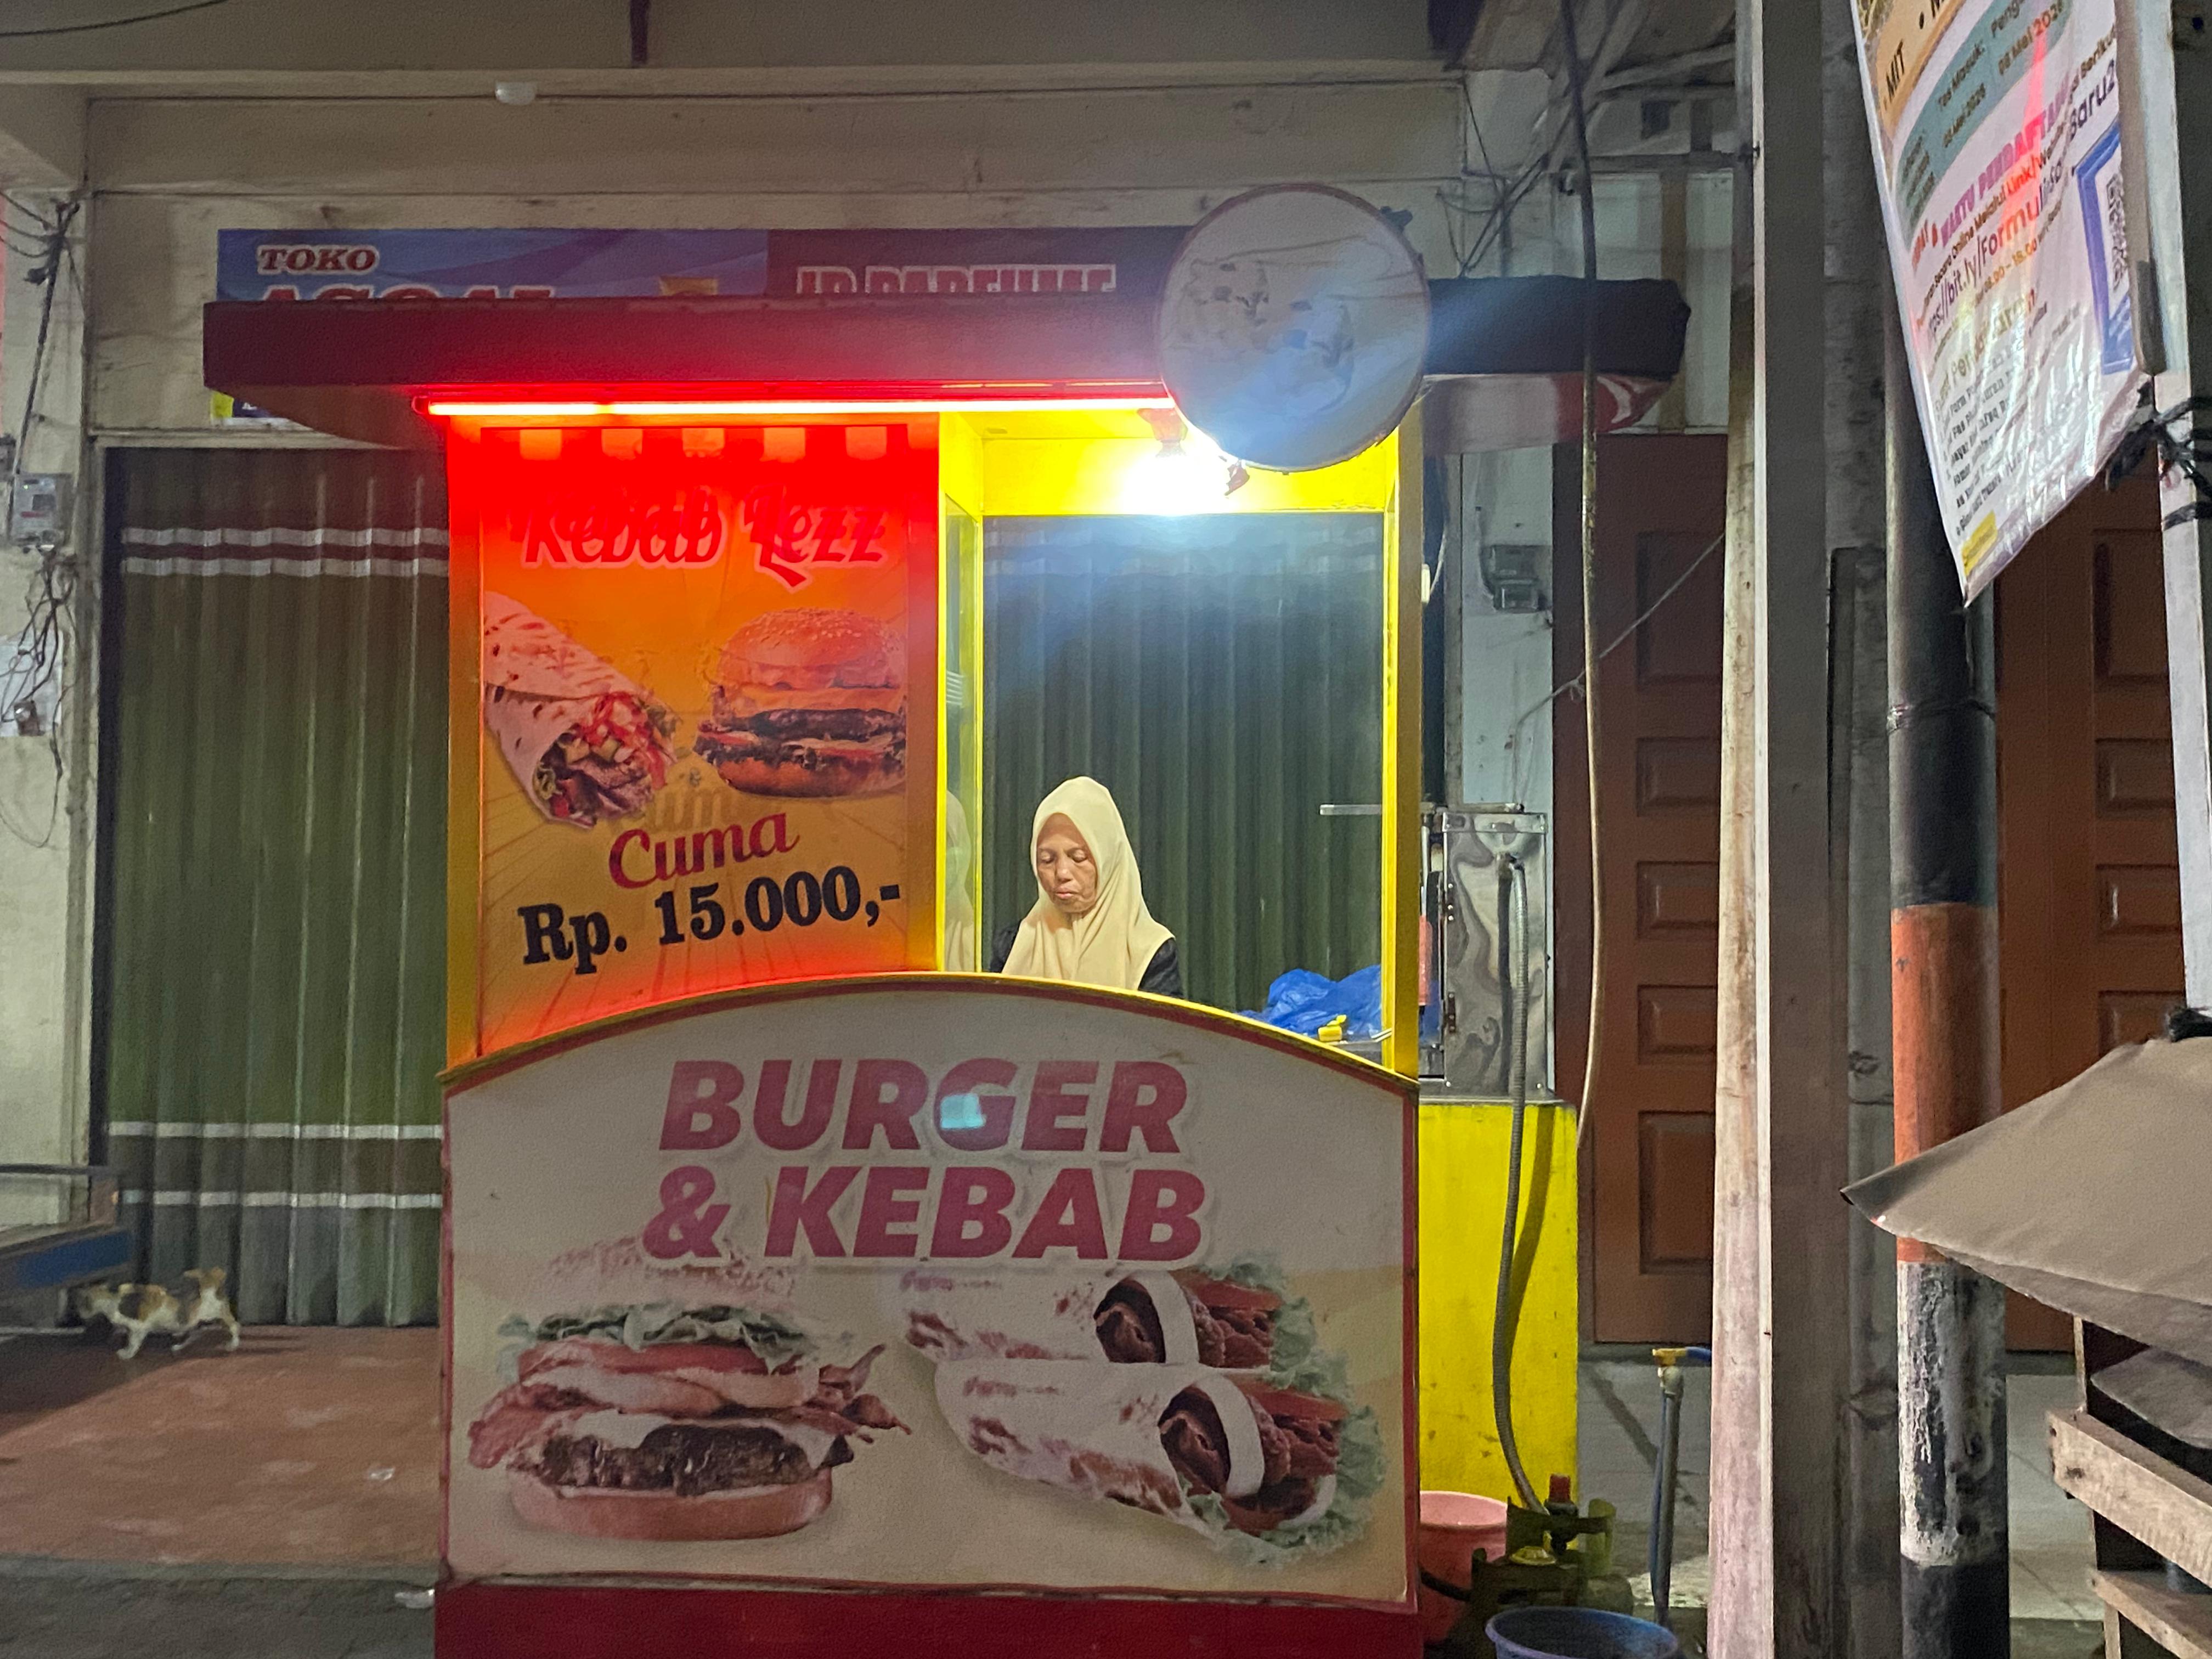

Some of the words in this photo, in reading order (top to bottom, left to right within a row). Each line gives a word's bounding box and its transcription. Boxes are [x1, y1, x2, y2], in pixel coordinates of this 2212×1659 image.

[1885, 38, 1905, 104] MIT
[258, 246, 377, 273] TOKO
[608, 812, 800, 889] Cuma
[517, 902, 627, 975] Rp.
[654, 865, 901, 946] 15.000,-
[659, 1058, 1188, 1154] BURGER
[642, 1165, 731, 1259] &
[764, 1166, 1206, 1262] KEBAB
